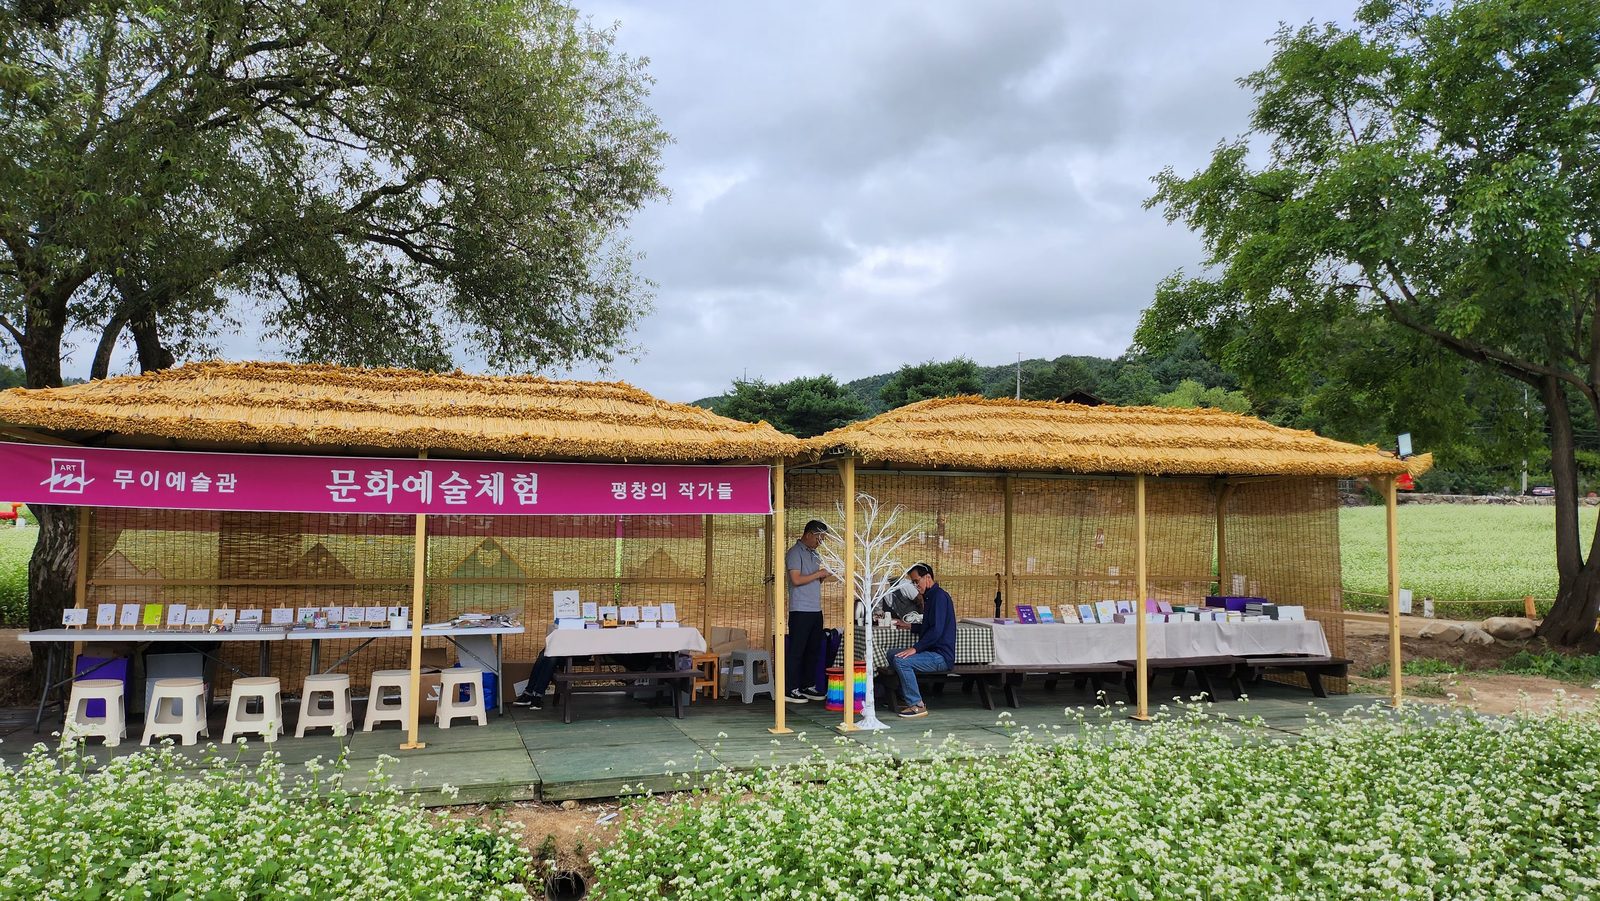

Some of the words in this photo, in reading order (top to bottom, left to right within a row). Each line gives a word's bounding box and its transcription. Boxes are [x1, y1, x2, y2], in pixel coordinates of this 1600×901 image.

[60, 464, 77, 472] ART
[112, 469, 238, 493] 무이예술관
[325, 468, 539, 506] 문화예술체험
[611, 481, 668, 500] 평창의
[678, 482, 734, 500] 작가들
